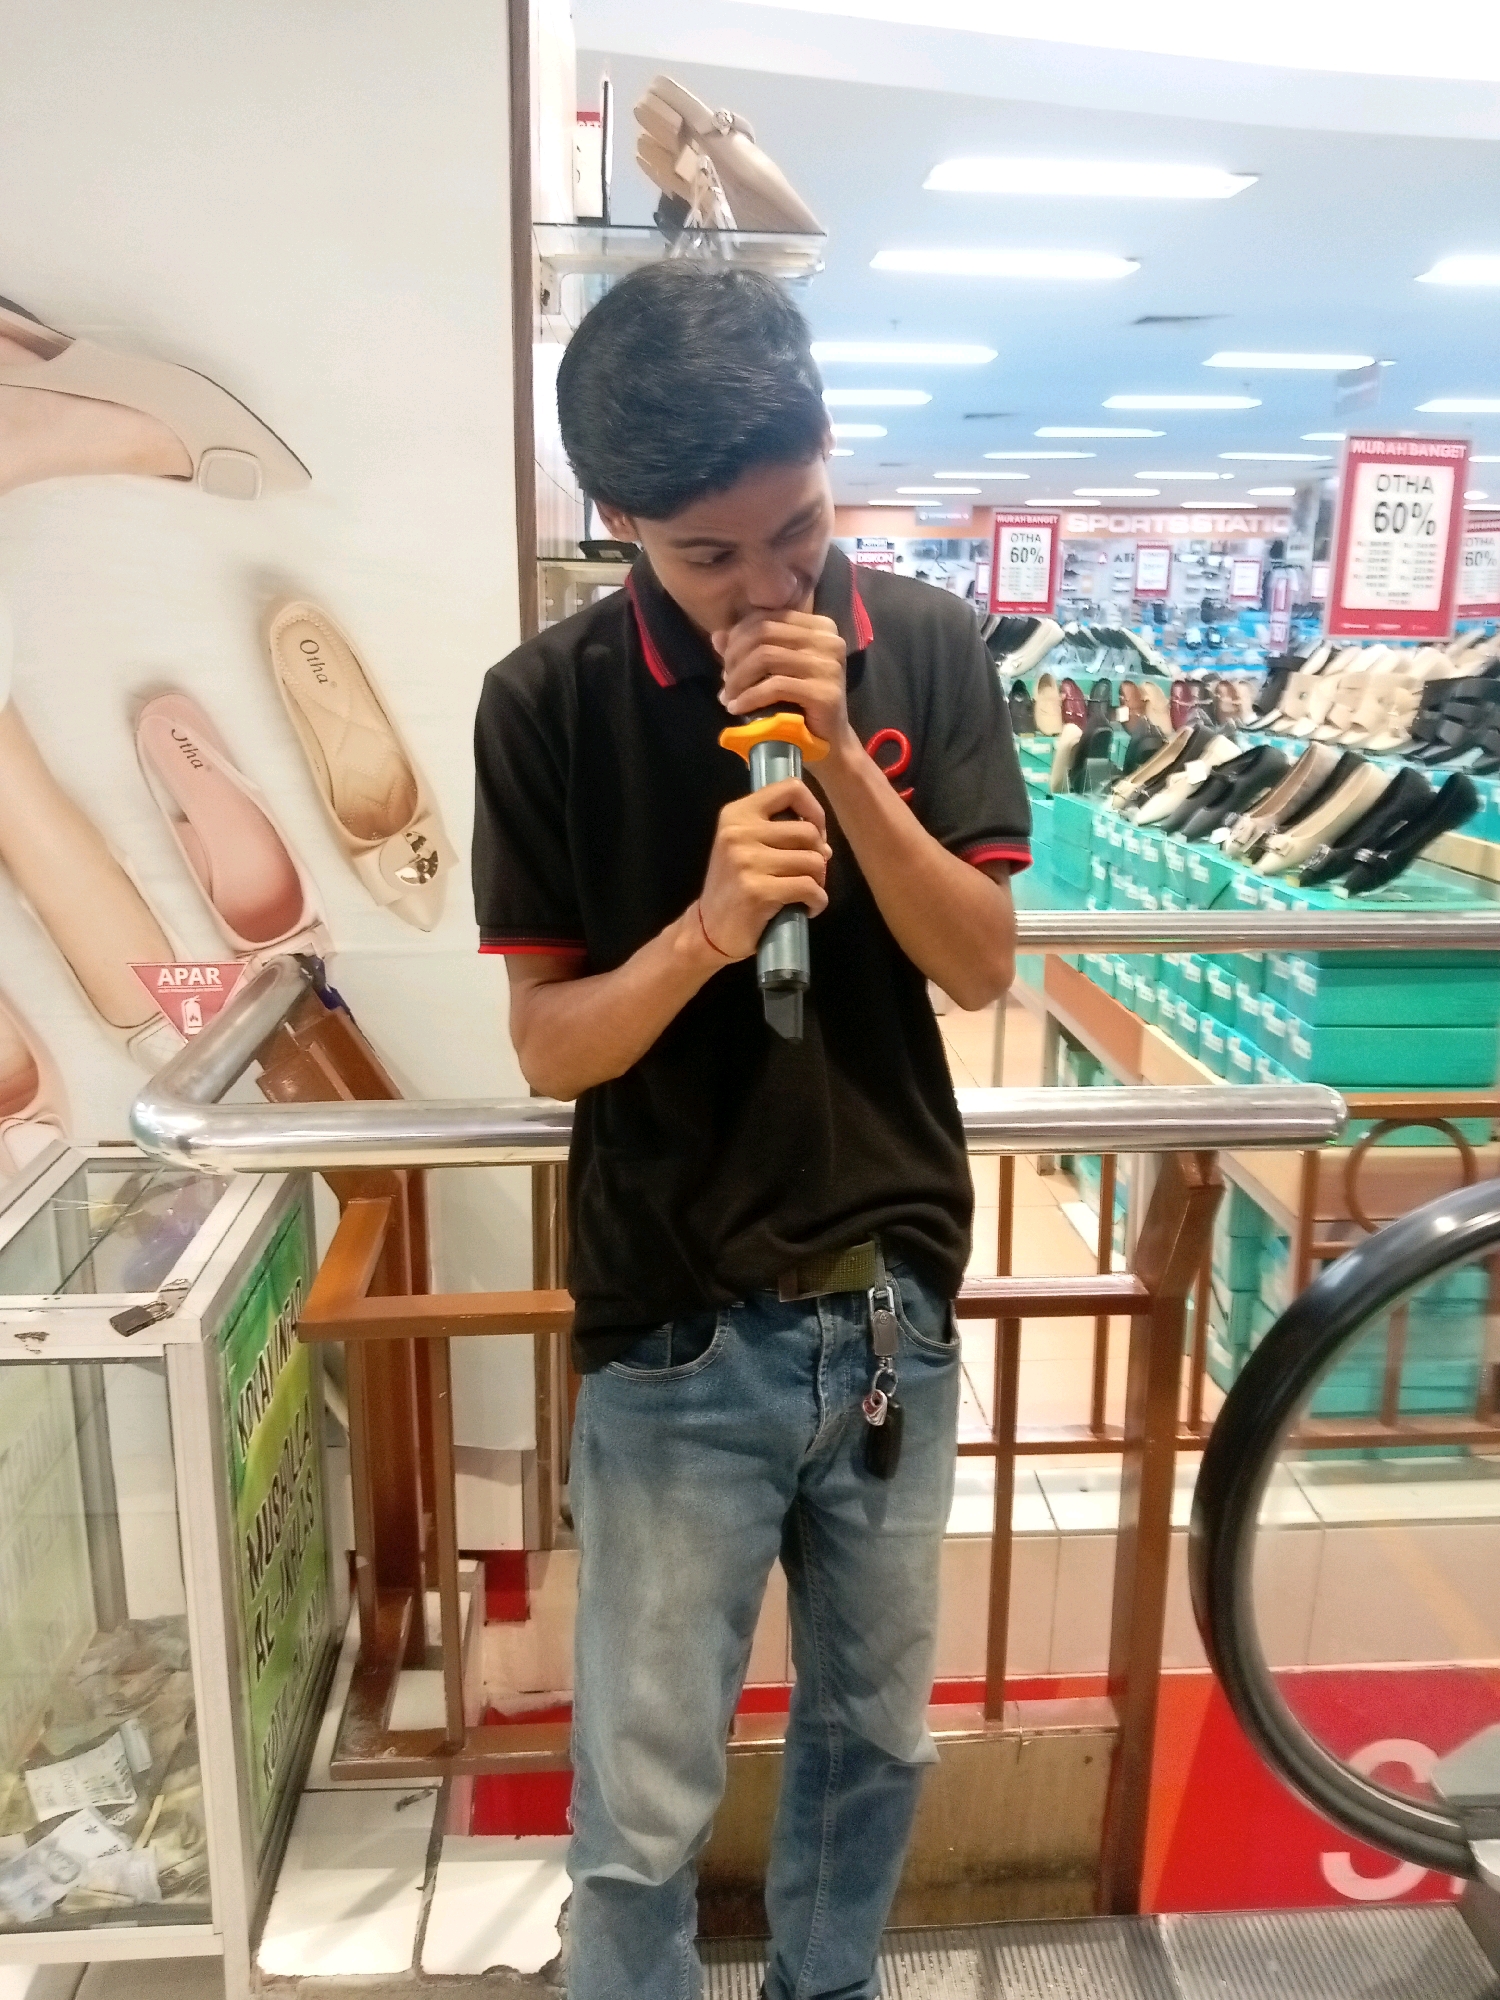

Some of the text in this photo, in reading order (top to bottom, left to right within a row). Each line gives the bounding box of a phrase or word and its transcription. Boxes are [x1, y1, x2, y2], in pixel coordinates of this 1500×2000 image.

[1376, 474, 1435, 494] OTHA
[1374, 501, 1436, 536] 60%
[1010, 533, 1042, 543] OTHA
[1465, 537, 1496, 547] OTHA
[1010, 546, 1044, 564] 60%
[1465, 551, 1498, 566] 60%
[299, 639, 329, 685] Otha
[157, 967, 222, 986] APAR
[246, 1393, 312, 1601] MUSHOLLA
